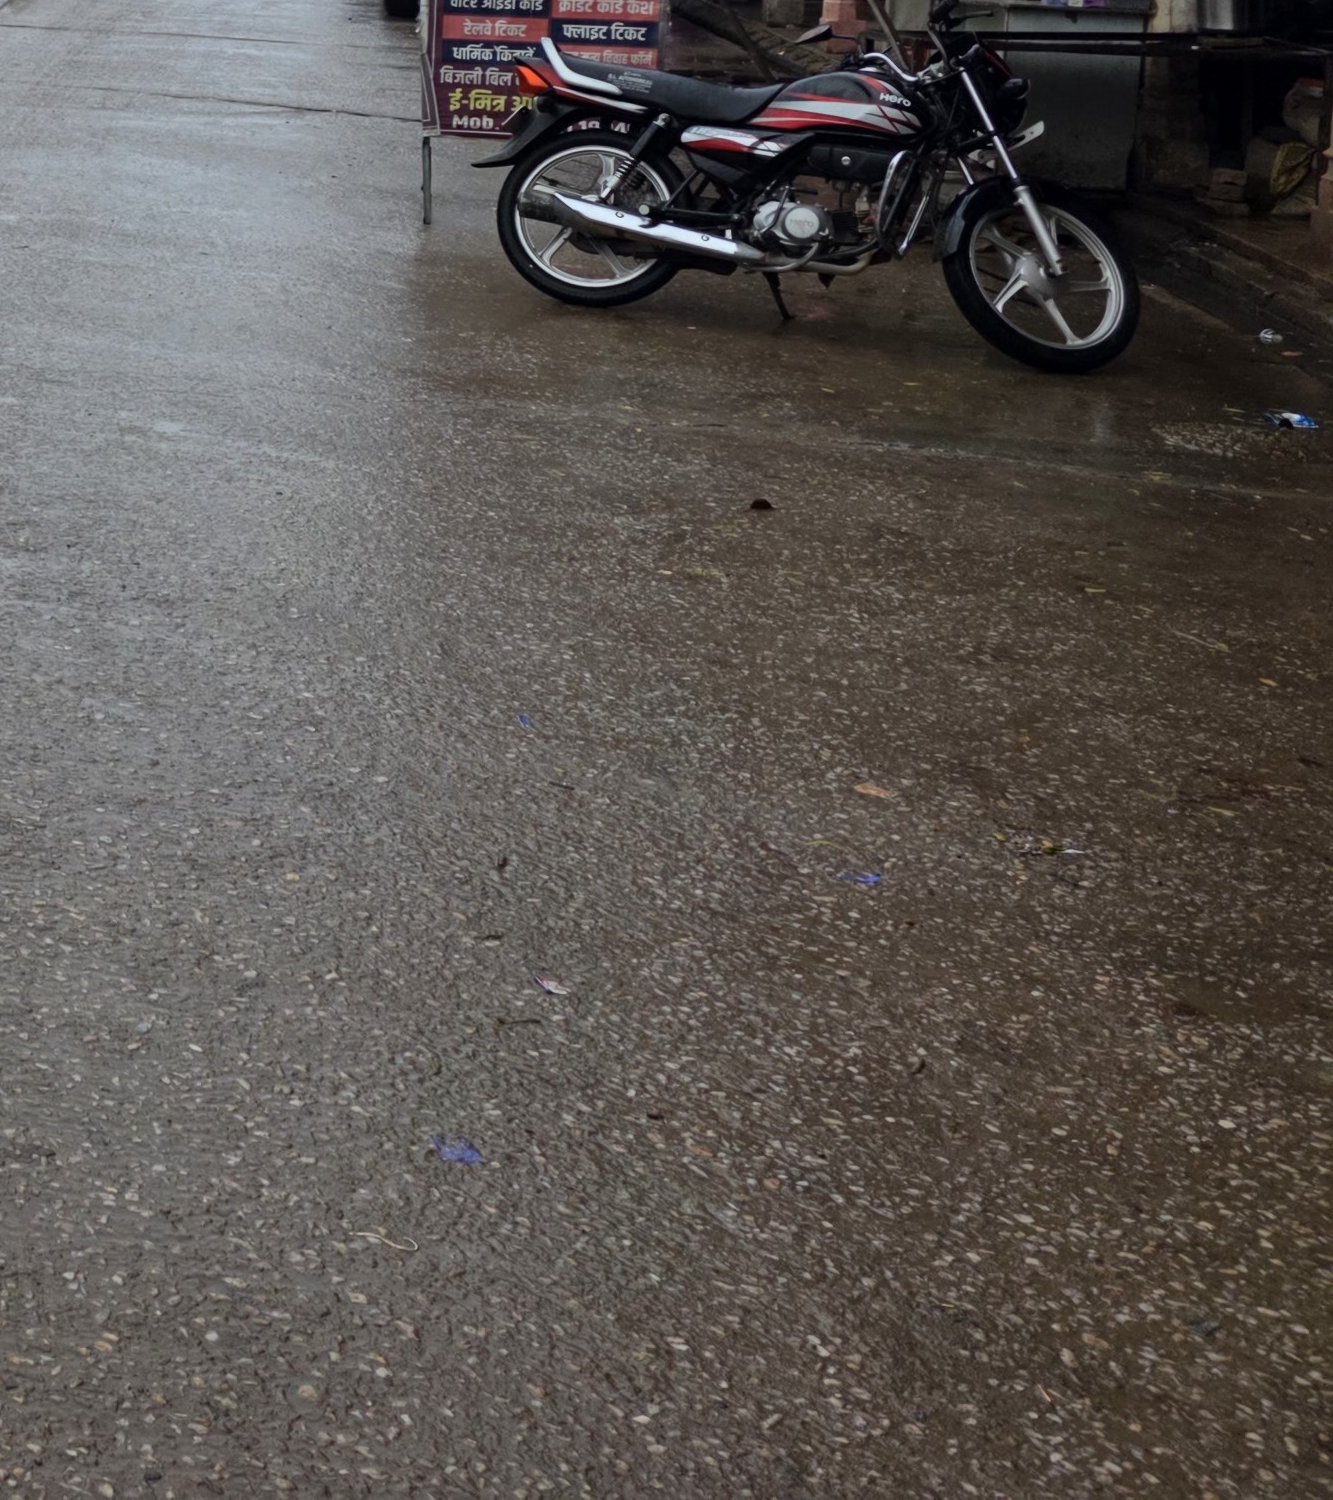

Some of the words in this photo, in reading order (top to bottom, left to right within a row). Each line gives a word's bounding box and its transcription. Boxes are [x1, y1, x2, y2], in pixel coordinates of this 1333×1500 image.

[463, 18, 492, 37] रेलवे
[494, 19, 527, 38] टिकट
[562, 23, 608, 41] फ्लाइट
[610, 23, 647, 42] टिकट
[452, 43, 494, 62] धार्मिक
[439, 66, 482, 86] बिजली
[484, 67, 513, 87] बिल
[448, 89, 506, 113] ई-मित्र
[879, 92, 912, 108] Hero
[452, 113, 501, 131] Mob.
